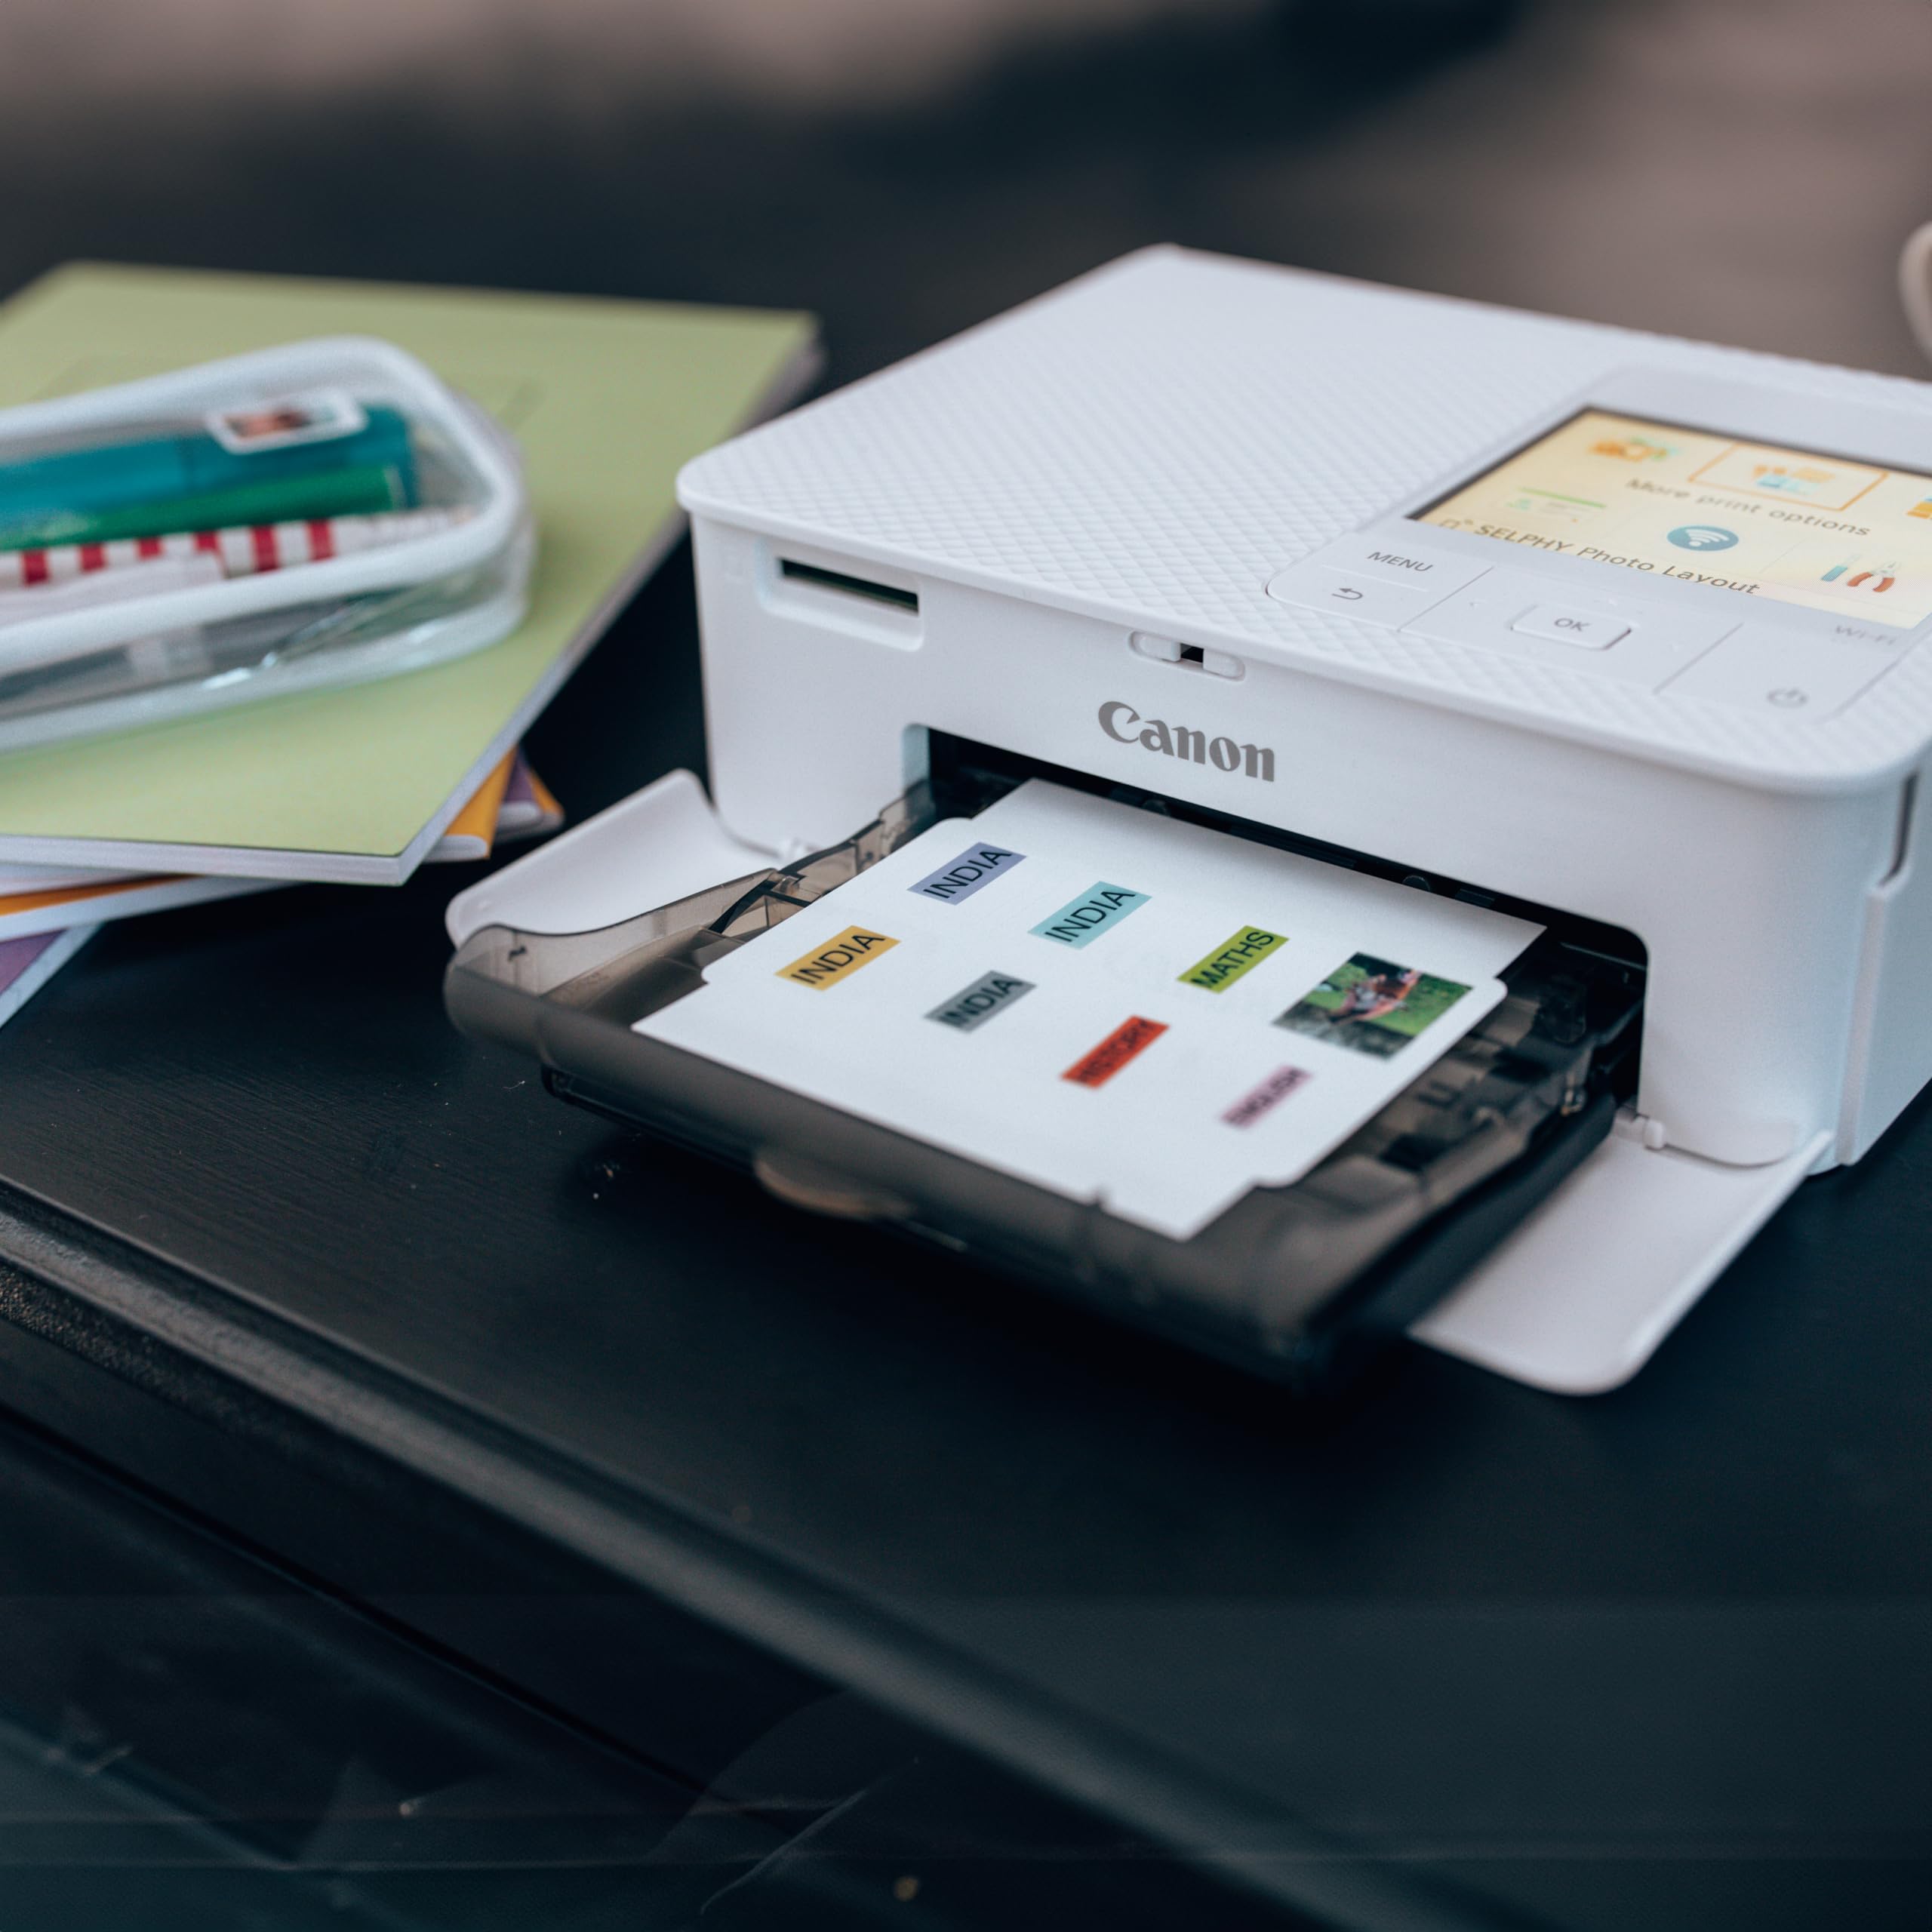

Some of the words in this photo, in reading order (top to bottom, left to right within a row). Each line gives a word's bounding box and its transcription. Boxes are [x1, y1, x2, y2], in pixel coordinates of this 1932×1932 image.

[1626, 477, 1690, 500] More
[1696, 494, 1762, 515] print
[1768, 509, 1871, 537] options
[1367, 552, 1434, 572] MENU
[1474, 525, 1574, 552] SELPHY
[1577, 546, 1655, 571] Photo
[1662, 565, 1761, 594] Layout
[1554, 617, 1592, 632] OK
[1098, 700, 1275, 783] Canon
[923, 848, 1013, 900] INDIA
[1044, 891, 1137, 943] INDIA
[790, 934, 886, 986] INDIA
[1189, 931, 1275, 989] MATHS
